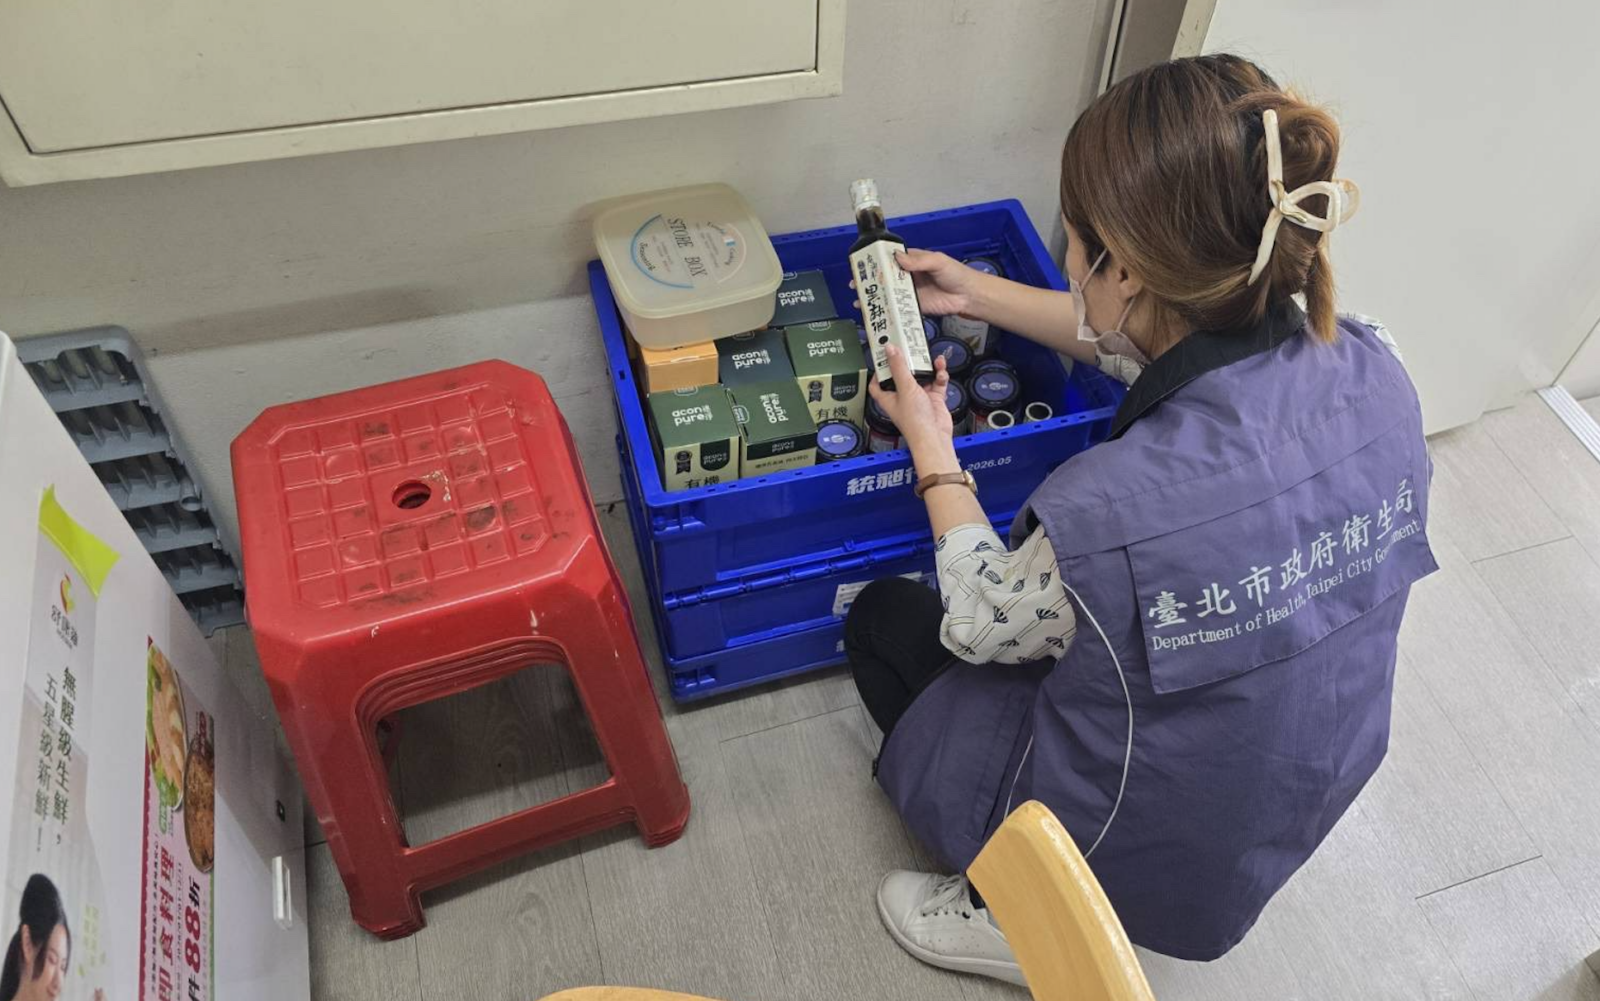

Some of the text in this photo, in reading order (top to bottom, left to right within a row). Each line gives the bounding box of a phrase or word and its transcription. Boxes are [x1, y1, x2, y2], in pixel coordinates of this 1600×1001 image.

[667, 218, 694, 248] STORE
[684, 256, 708, 277] BOX
[778, 289, 805, 298] acon
[780, 295, 807, 306] pure
[807, 340, 835, 349] acon
[732, 351, 760, 361] acon
[808, 346, 836, 357] pure
[734, 357, 762, 369] pure
[672, 406, 702, 417] acon
[763, 400, 777, 423] acon
[771, 399, 789, 422] pure
[817, 406, 848, 420] 有機
[674, 413, 705, 426] pure
[966, 455, 1012, 472] 2026.05
[1149, 479, 1413, 628] 臺北市政府衛生局
[1152, 624, 1242, 650] Department
[1245, 613, 1263, 632] of
[1306, 567, 1343, 600] Taipei
[1347, 556, 1373, 580] City
